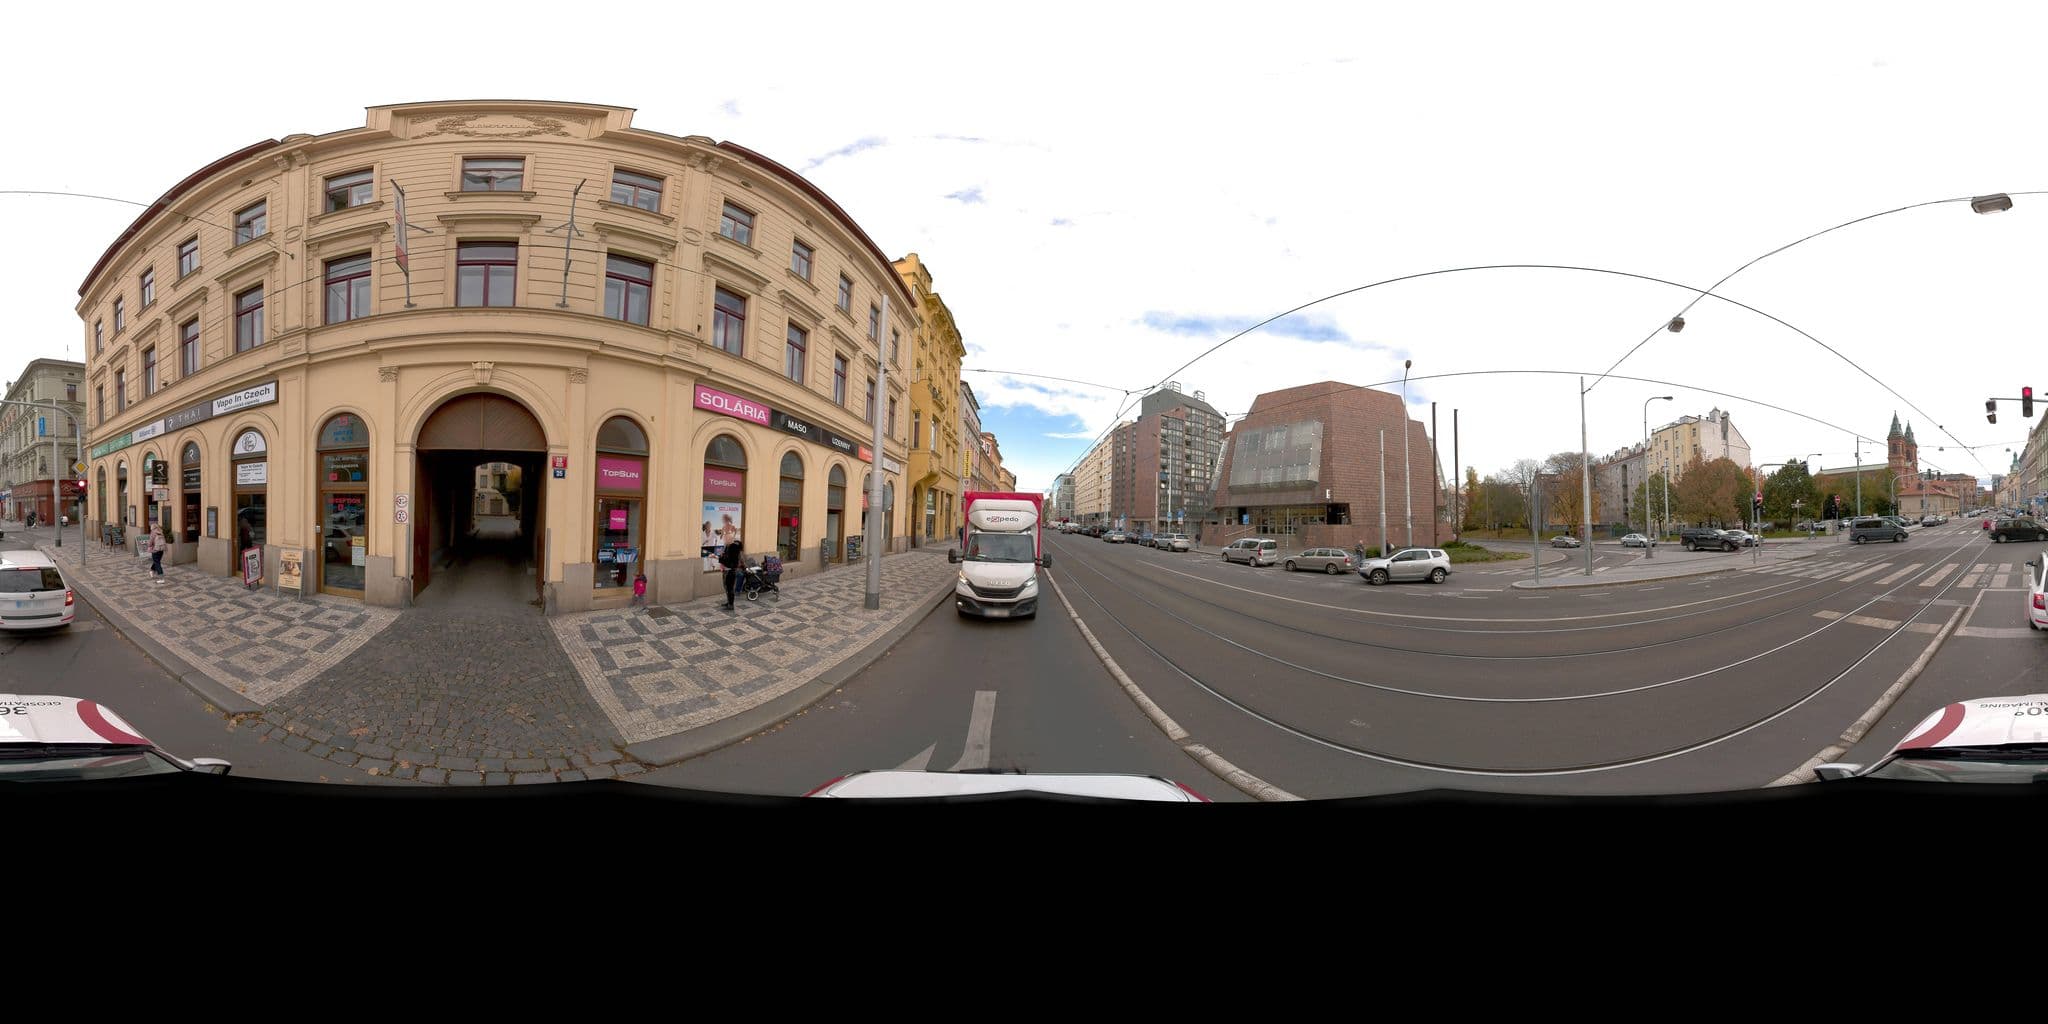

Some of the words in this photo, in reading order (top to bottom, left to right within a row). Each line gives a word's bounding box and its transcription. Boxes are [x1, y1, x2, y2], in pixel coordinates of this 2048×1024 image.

[216, 398, 233, 409] Vape
[234, 395, 242, 403] In
[244, 387, 270, 400] Czech
[700, 391, 767, 423] SOLÁRIA
[178, 408, 200, 423] THAI
[787, 419, 807, 434] MASO
